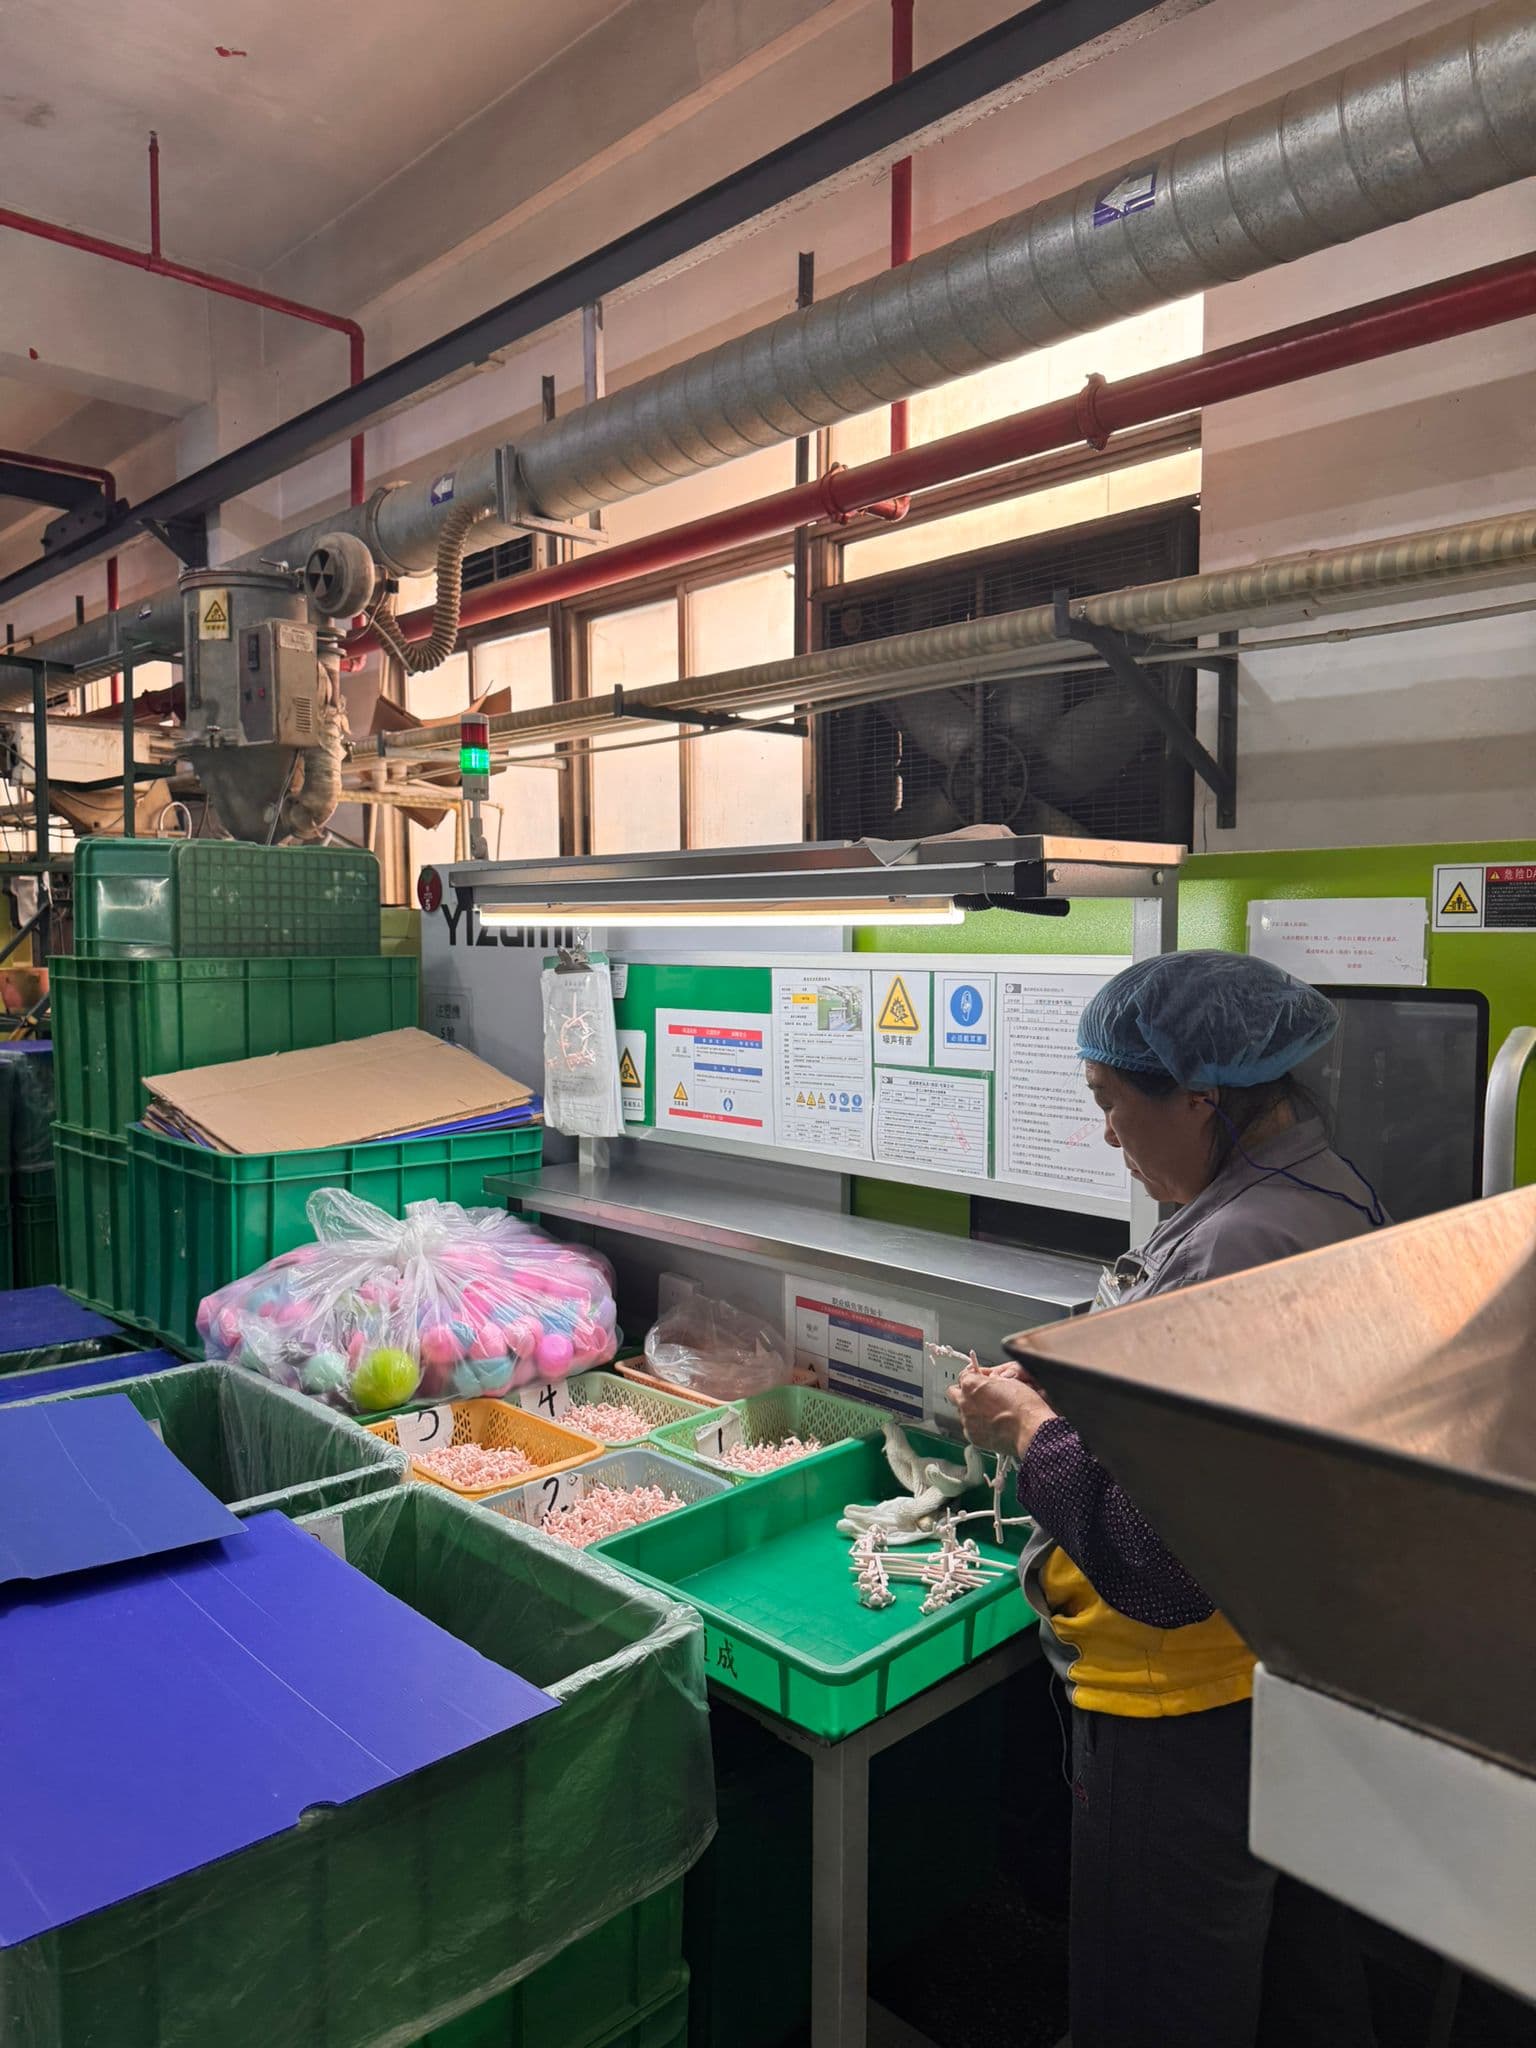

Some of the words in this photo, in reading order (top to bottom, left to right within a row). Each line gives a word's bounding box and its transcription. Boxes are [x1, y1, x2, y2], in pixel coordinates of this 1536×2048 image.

[882, 1035, 913, 1046] 噪声有害
[538, 1384, 557, 1417] 4
[718, 1427, 723, 1454] 1
[543, 1477, 568, 1526] 2
